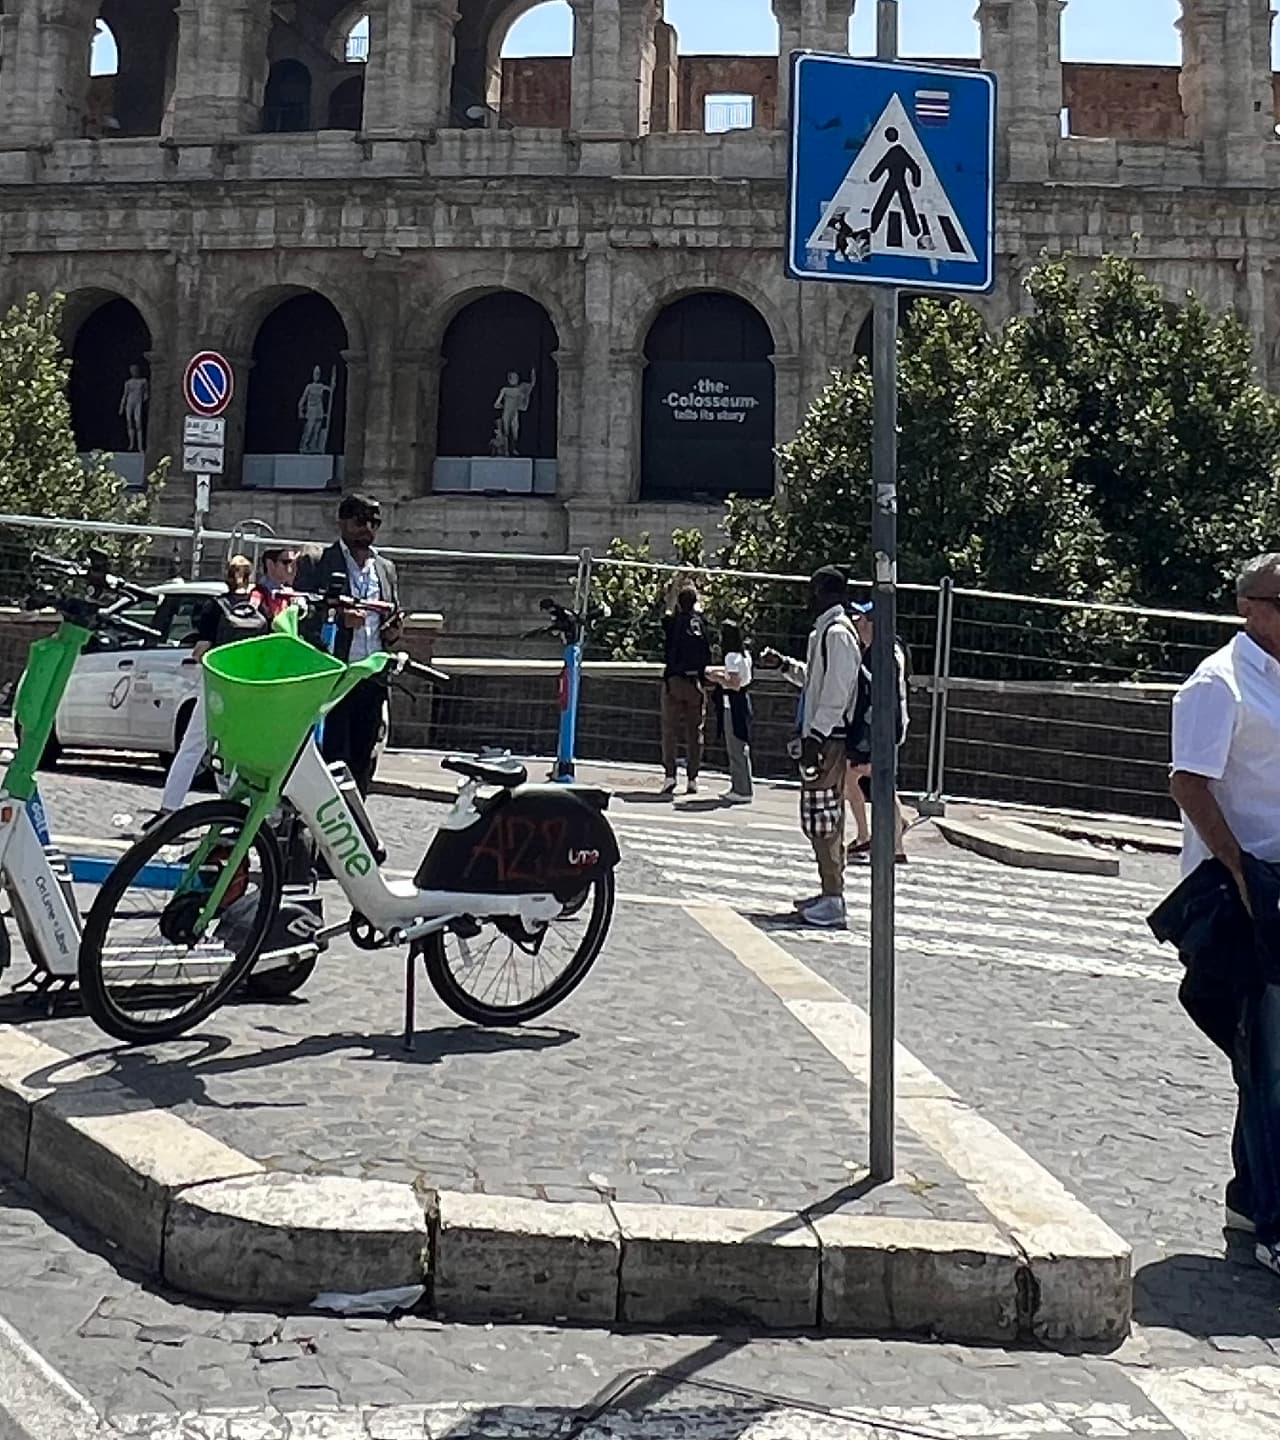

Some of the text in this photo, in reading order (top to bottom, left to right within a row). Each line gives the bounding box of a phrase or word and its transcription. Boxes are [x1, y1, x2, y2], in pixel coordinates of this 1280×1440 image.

[697, 379, 724, 393] the
[667, 392, 756, 408] Colosseum
[316, 795, 371, 878] Lime
